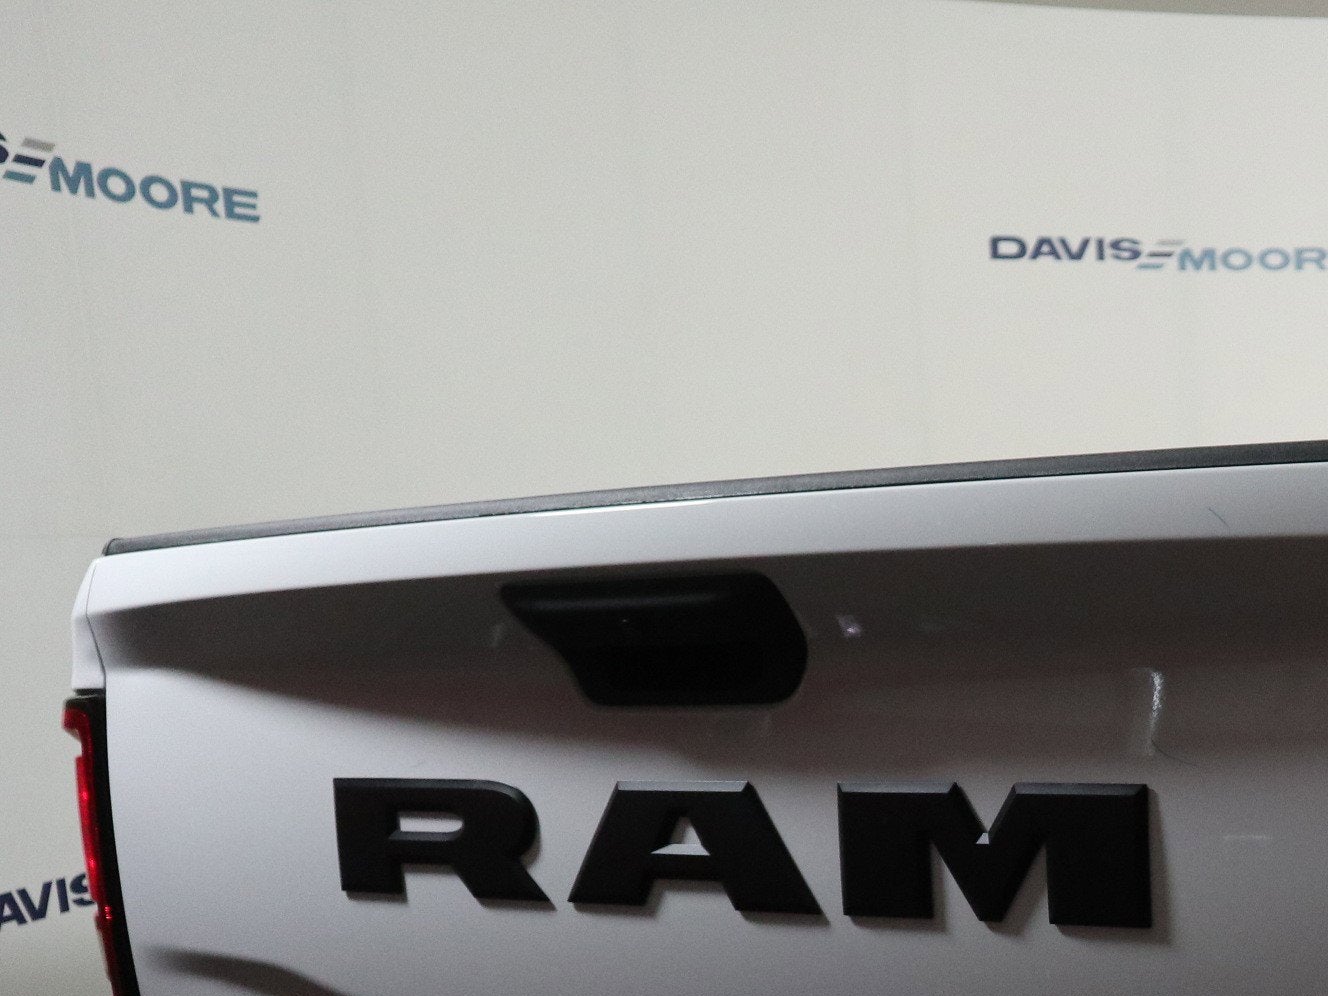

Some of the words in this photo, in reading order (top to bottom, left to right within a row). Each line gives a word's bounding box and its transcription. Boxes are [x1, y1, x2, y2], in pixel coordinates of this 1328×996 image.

[49, 156, 260, 224] MOORE
[989, 236, 1142, 261] DAVIS
[334, 778, 1153, 928] RAM
